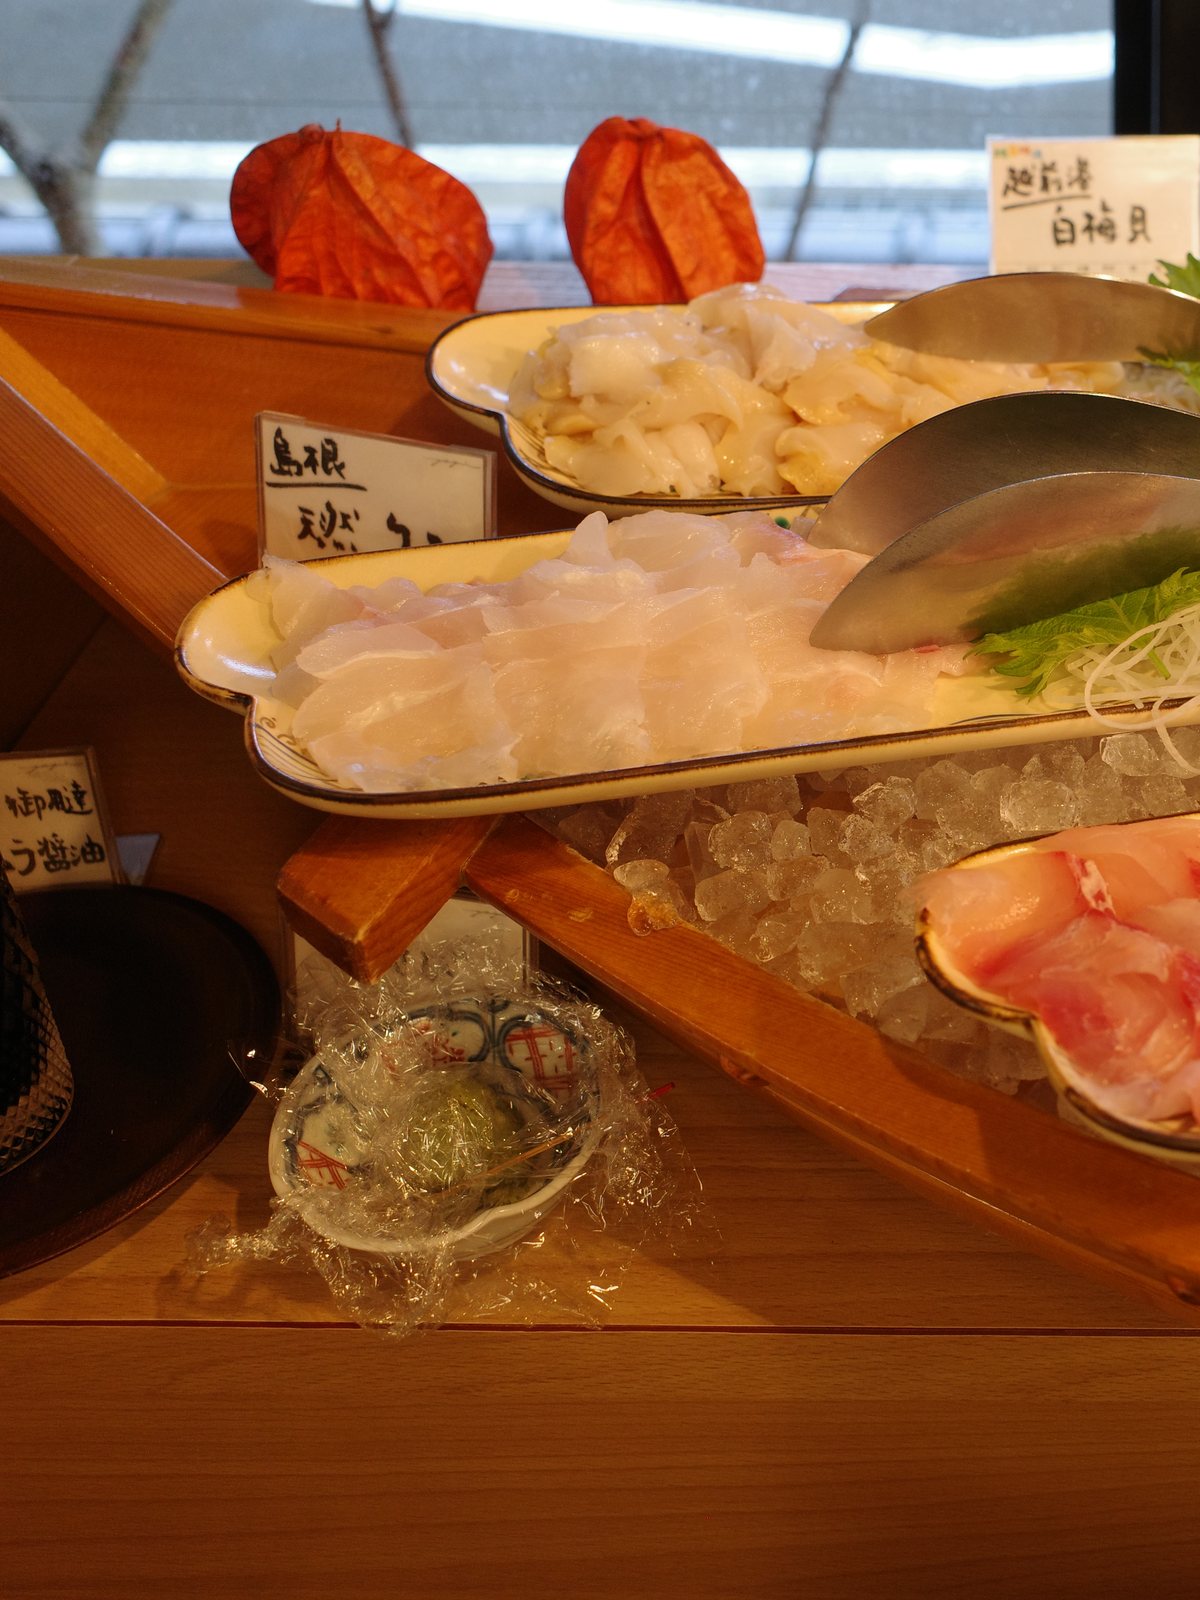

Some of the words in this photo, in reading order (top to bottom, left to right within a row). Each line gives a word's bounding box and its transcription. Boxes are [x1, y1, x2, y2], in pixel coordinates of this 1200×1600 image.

[1003, 154, 1092, 197] 越前港
[1052, 199, 1151, 246] 白梅貝
[270, 426, 346, 480] 島根
